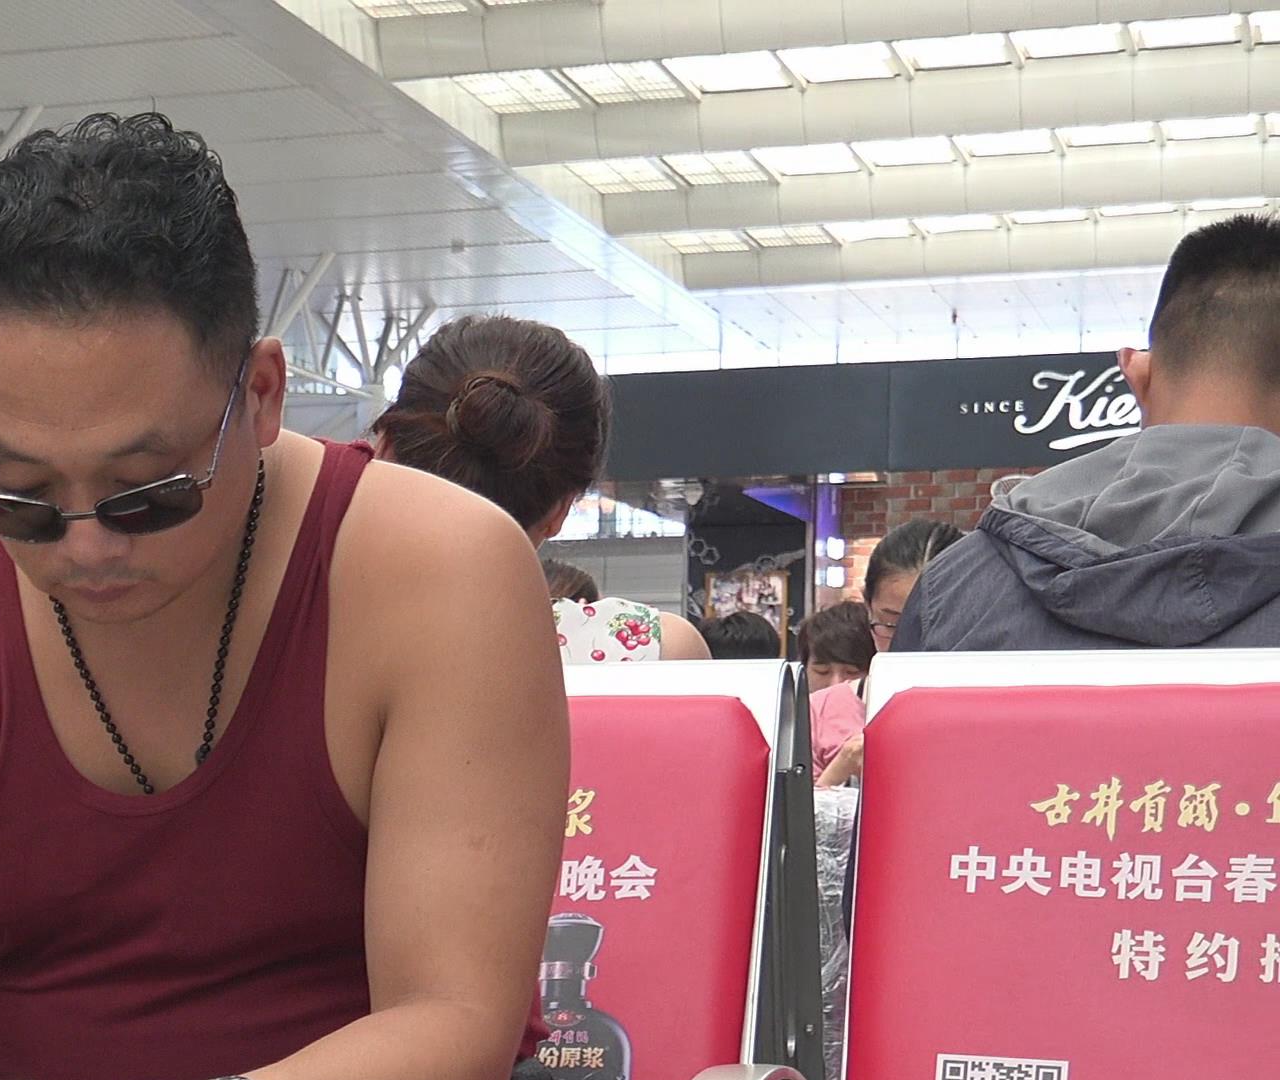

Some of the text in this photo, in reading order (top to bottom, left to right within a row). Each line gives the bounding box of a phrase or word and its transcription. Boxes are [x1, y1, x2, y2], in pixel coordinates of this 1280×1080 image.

[959, 366, 1142, 434] SINCE Kie
[949, 846, 1278, 904] 中央电视台春
